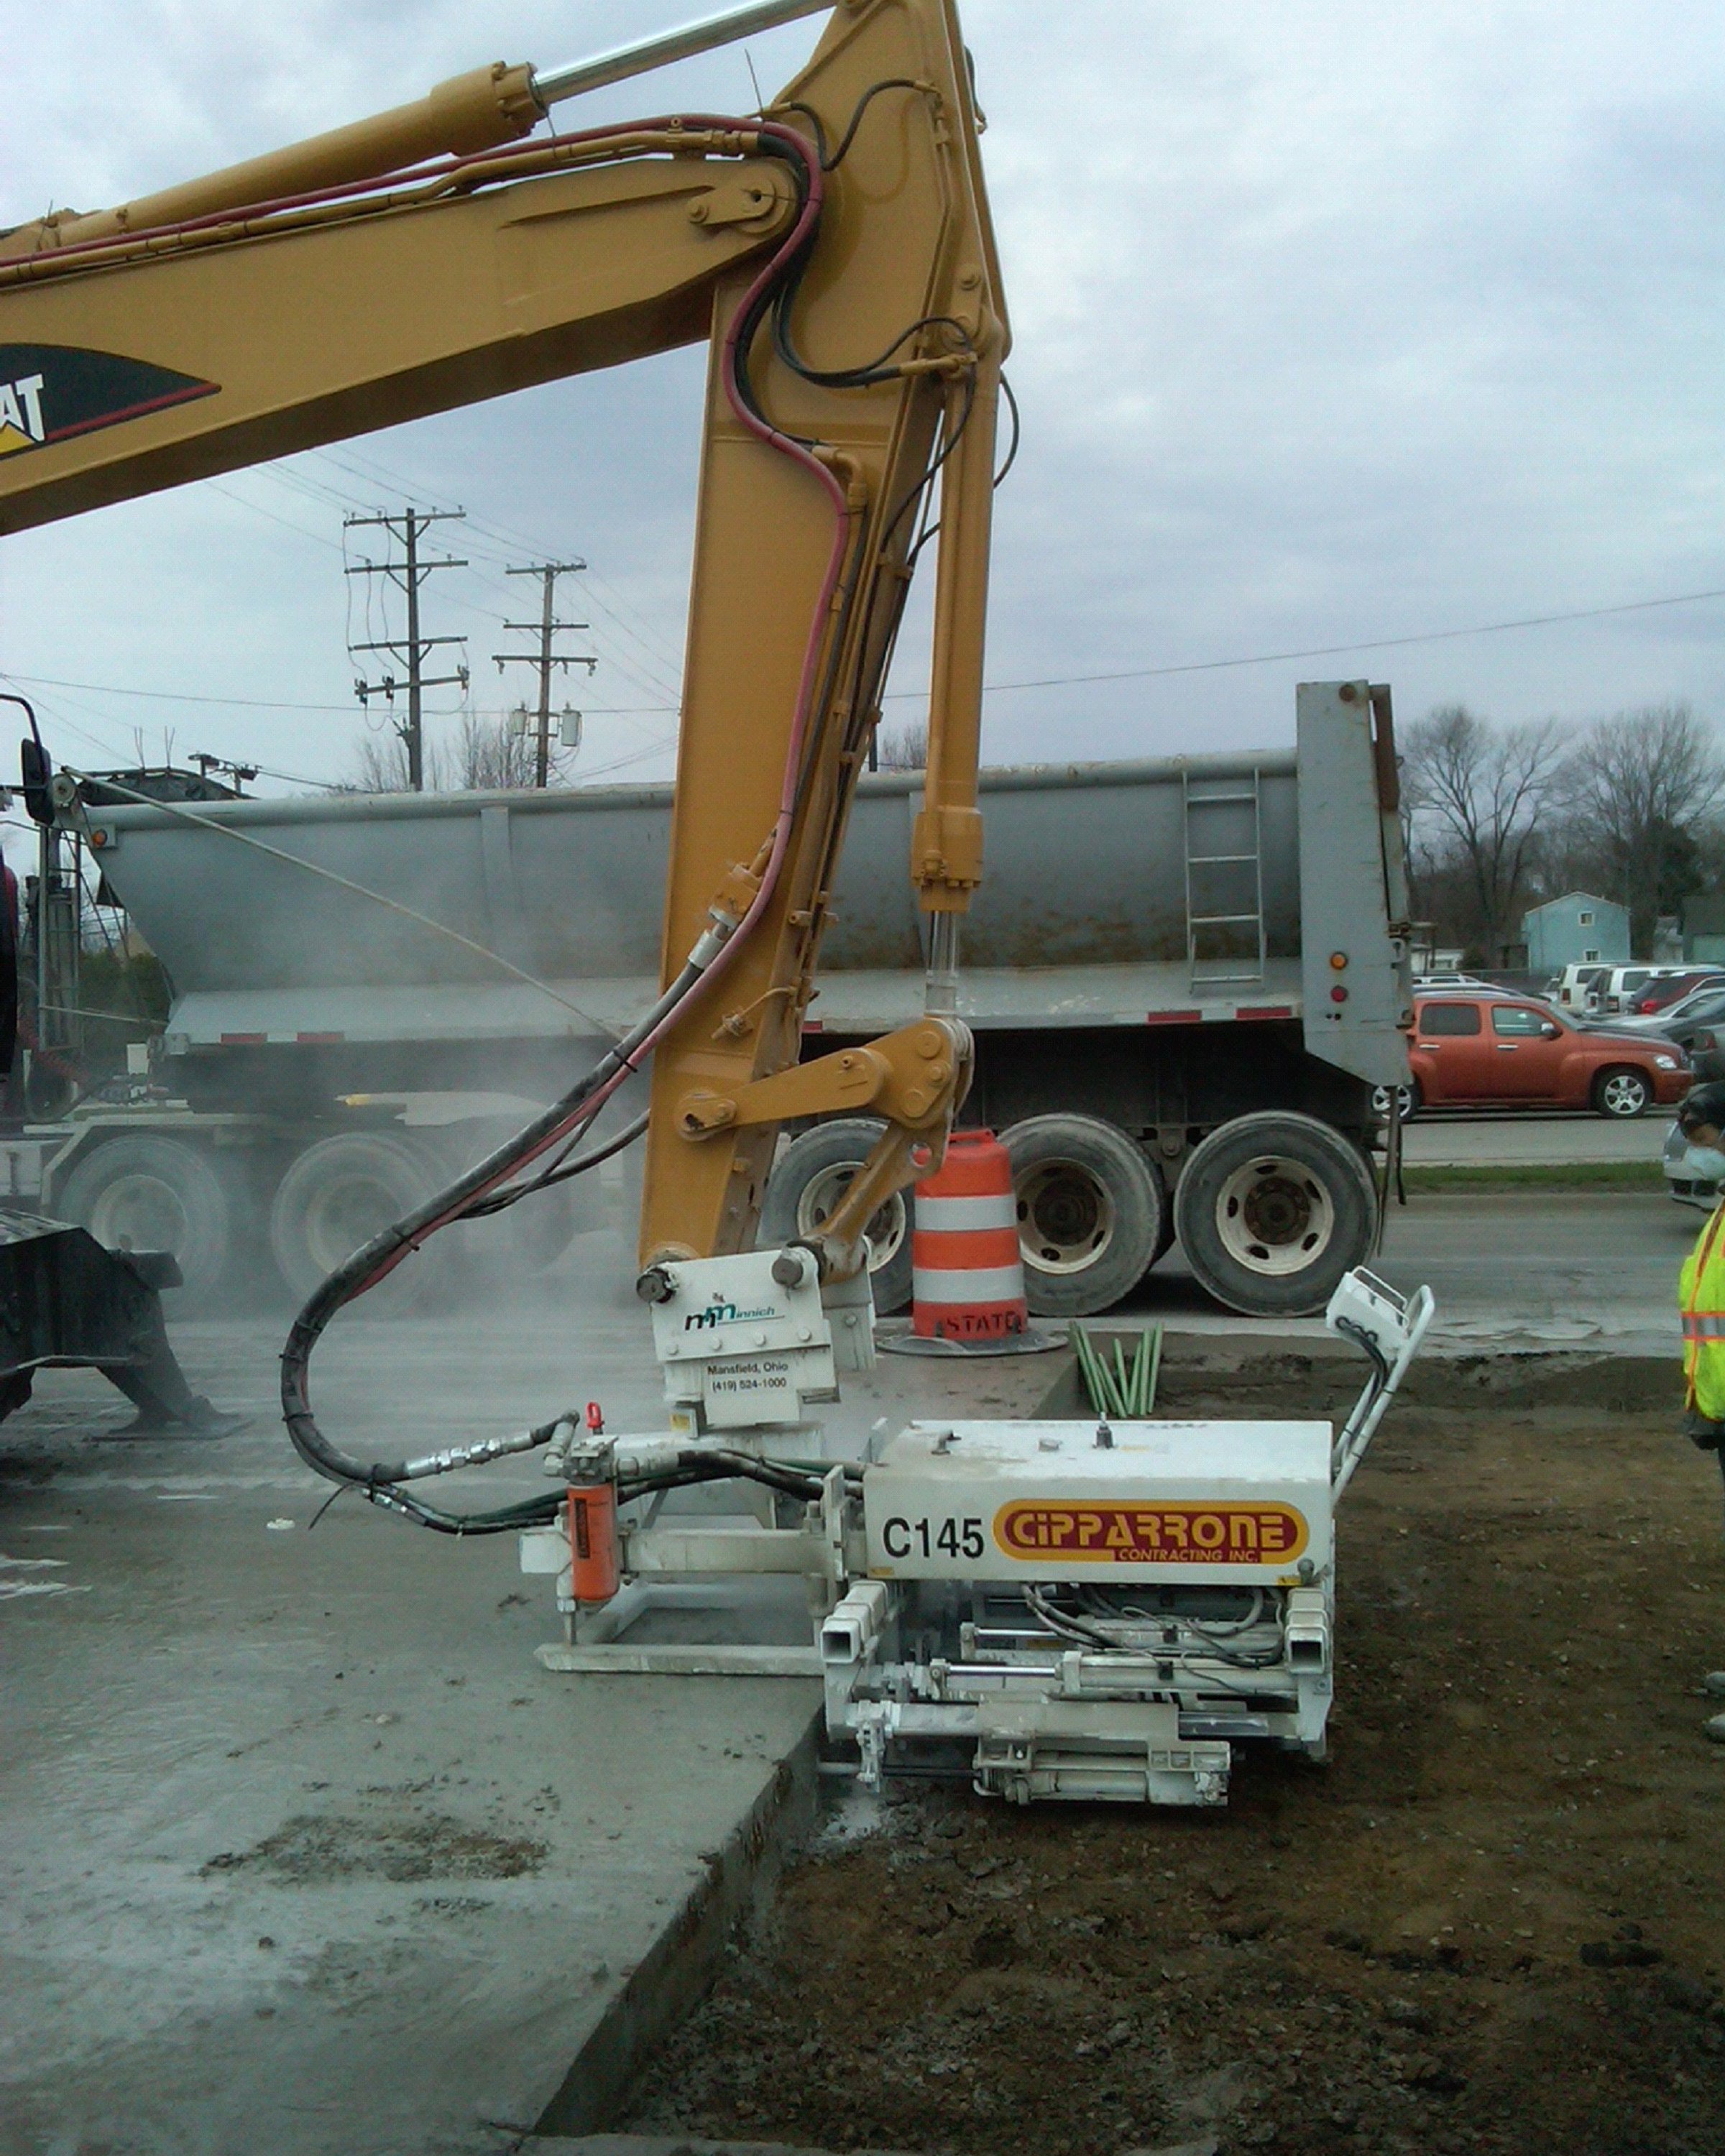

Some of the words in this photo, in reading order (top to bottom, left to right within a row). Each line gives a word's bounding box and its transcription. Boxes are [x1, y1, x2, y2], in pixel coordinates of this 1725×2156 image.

[0, 373, 45, 441] AT
[763, 1362, 789, 1372] Ohio
[883, 1516, 984, 1560] C145
[1119, 1548, 1223, 1561] CONTRACTING
